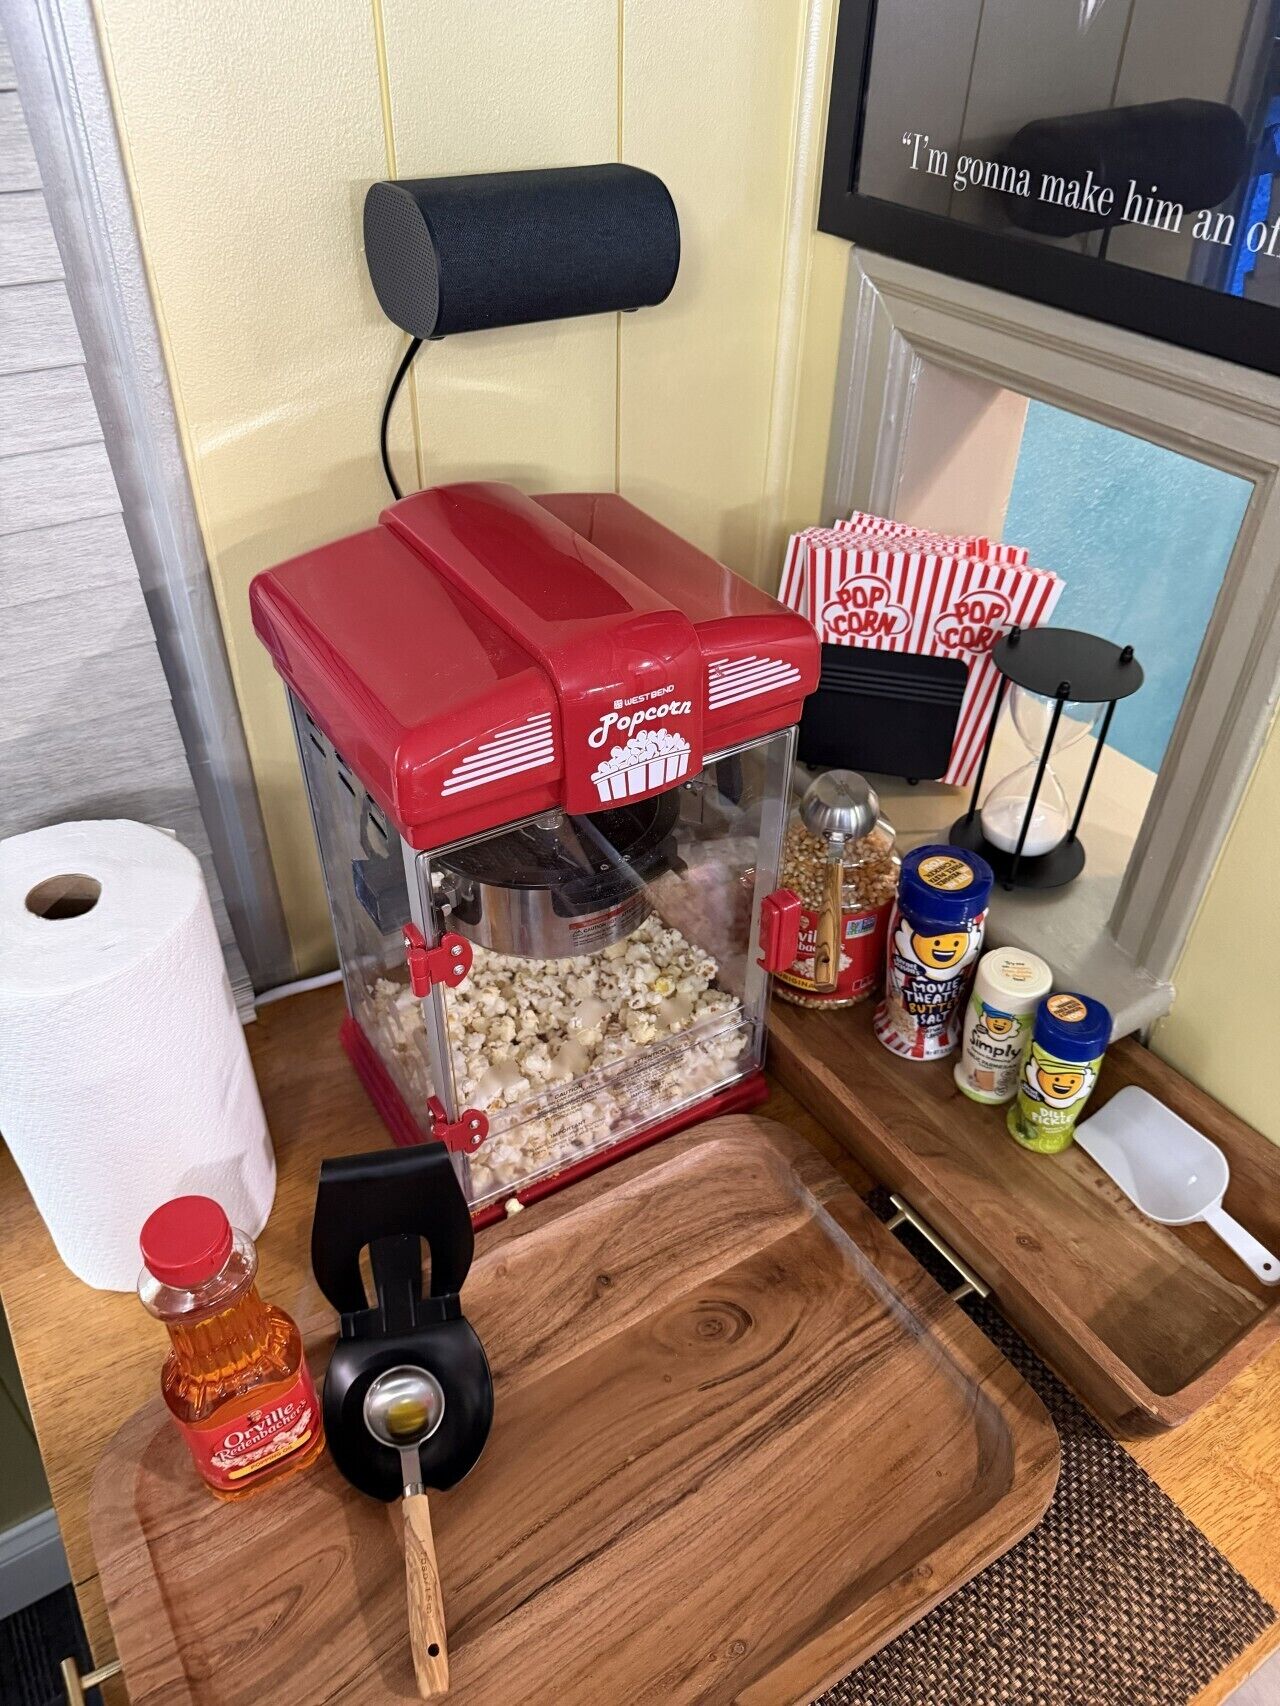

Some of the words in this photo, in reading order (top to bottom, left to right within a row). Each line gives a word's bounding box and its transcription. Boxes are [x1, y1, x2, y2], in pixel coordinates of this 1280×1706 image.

[952, 154, 1031, 197] gonna
[1037, 171, 1114, 216] make
[1120, 180, 1184, 233] him
[1192, 207, 1236, 246] an
[1247, 216, 1280, 258] of
[836, 586, 885, 611] POP
[954, 600, 1005, 625] POP
[833, 610, 898, 636] CORN
[588, 700, 692, 748] Popcorn
[780, 971, 816, 989] RIGINA
[912, 977, 960, 993] MOVIE
[904, 987, 959, 1005] THEATE
[908, 999, 953, 1014] BUTTE
[920, 1009, 950, 1025] SALT
[969, 1028, 1022, 1060] Simply
[554, 1083, 583, 1099] CAUTION
[1031, 1111, 1075, 1126] PICKLE
[1039, 1107, 1066, 1119] DILL
[223, 1402, 295, 1449] Orville
